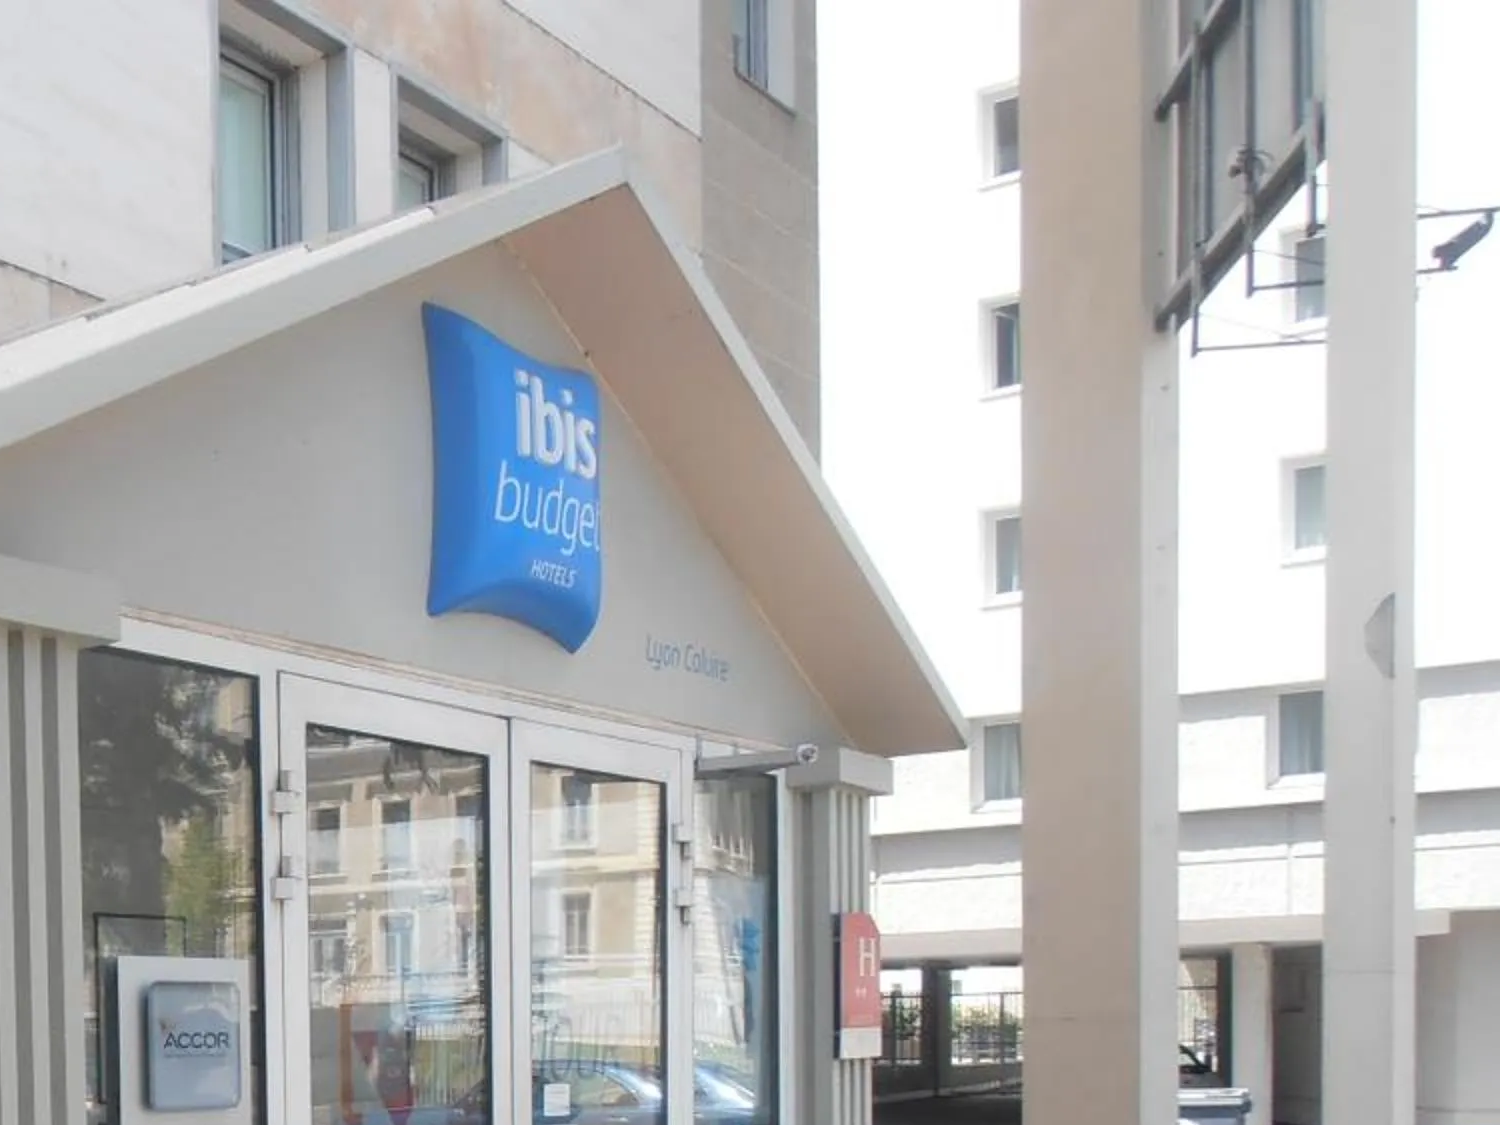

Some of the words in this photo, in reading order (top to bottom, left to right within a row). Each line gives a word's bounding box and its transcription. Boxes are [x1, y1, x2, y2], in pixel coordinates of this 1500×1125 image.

[515, 369, 596, 479] ibis
[531, 559, 577, 588] HOTELS
[859, 938, 877, 976] H
[163, 1031, 230, 1049] ACCOR
